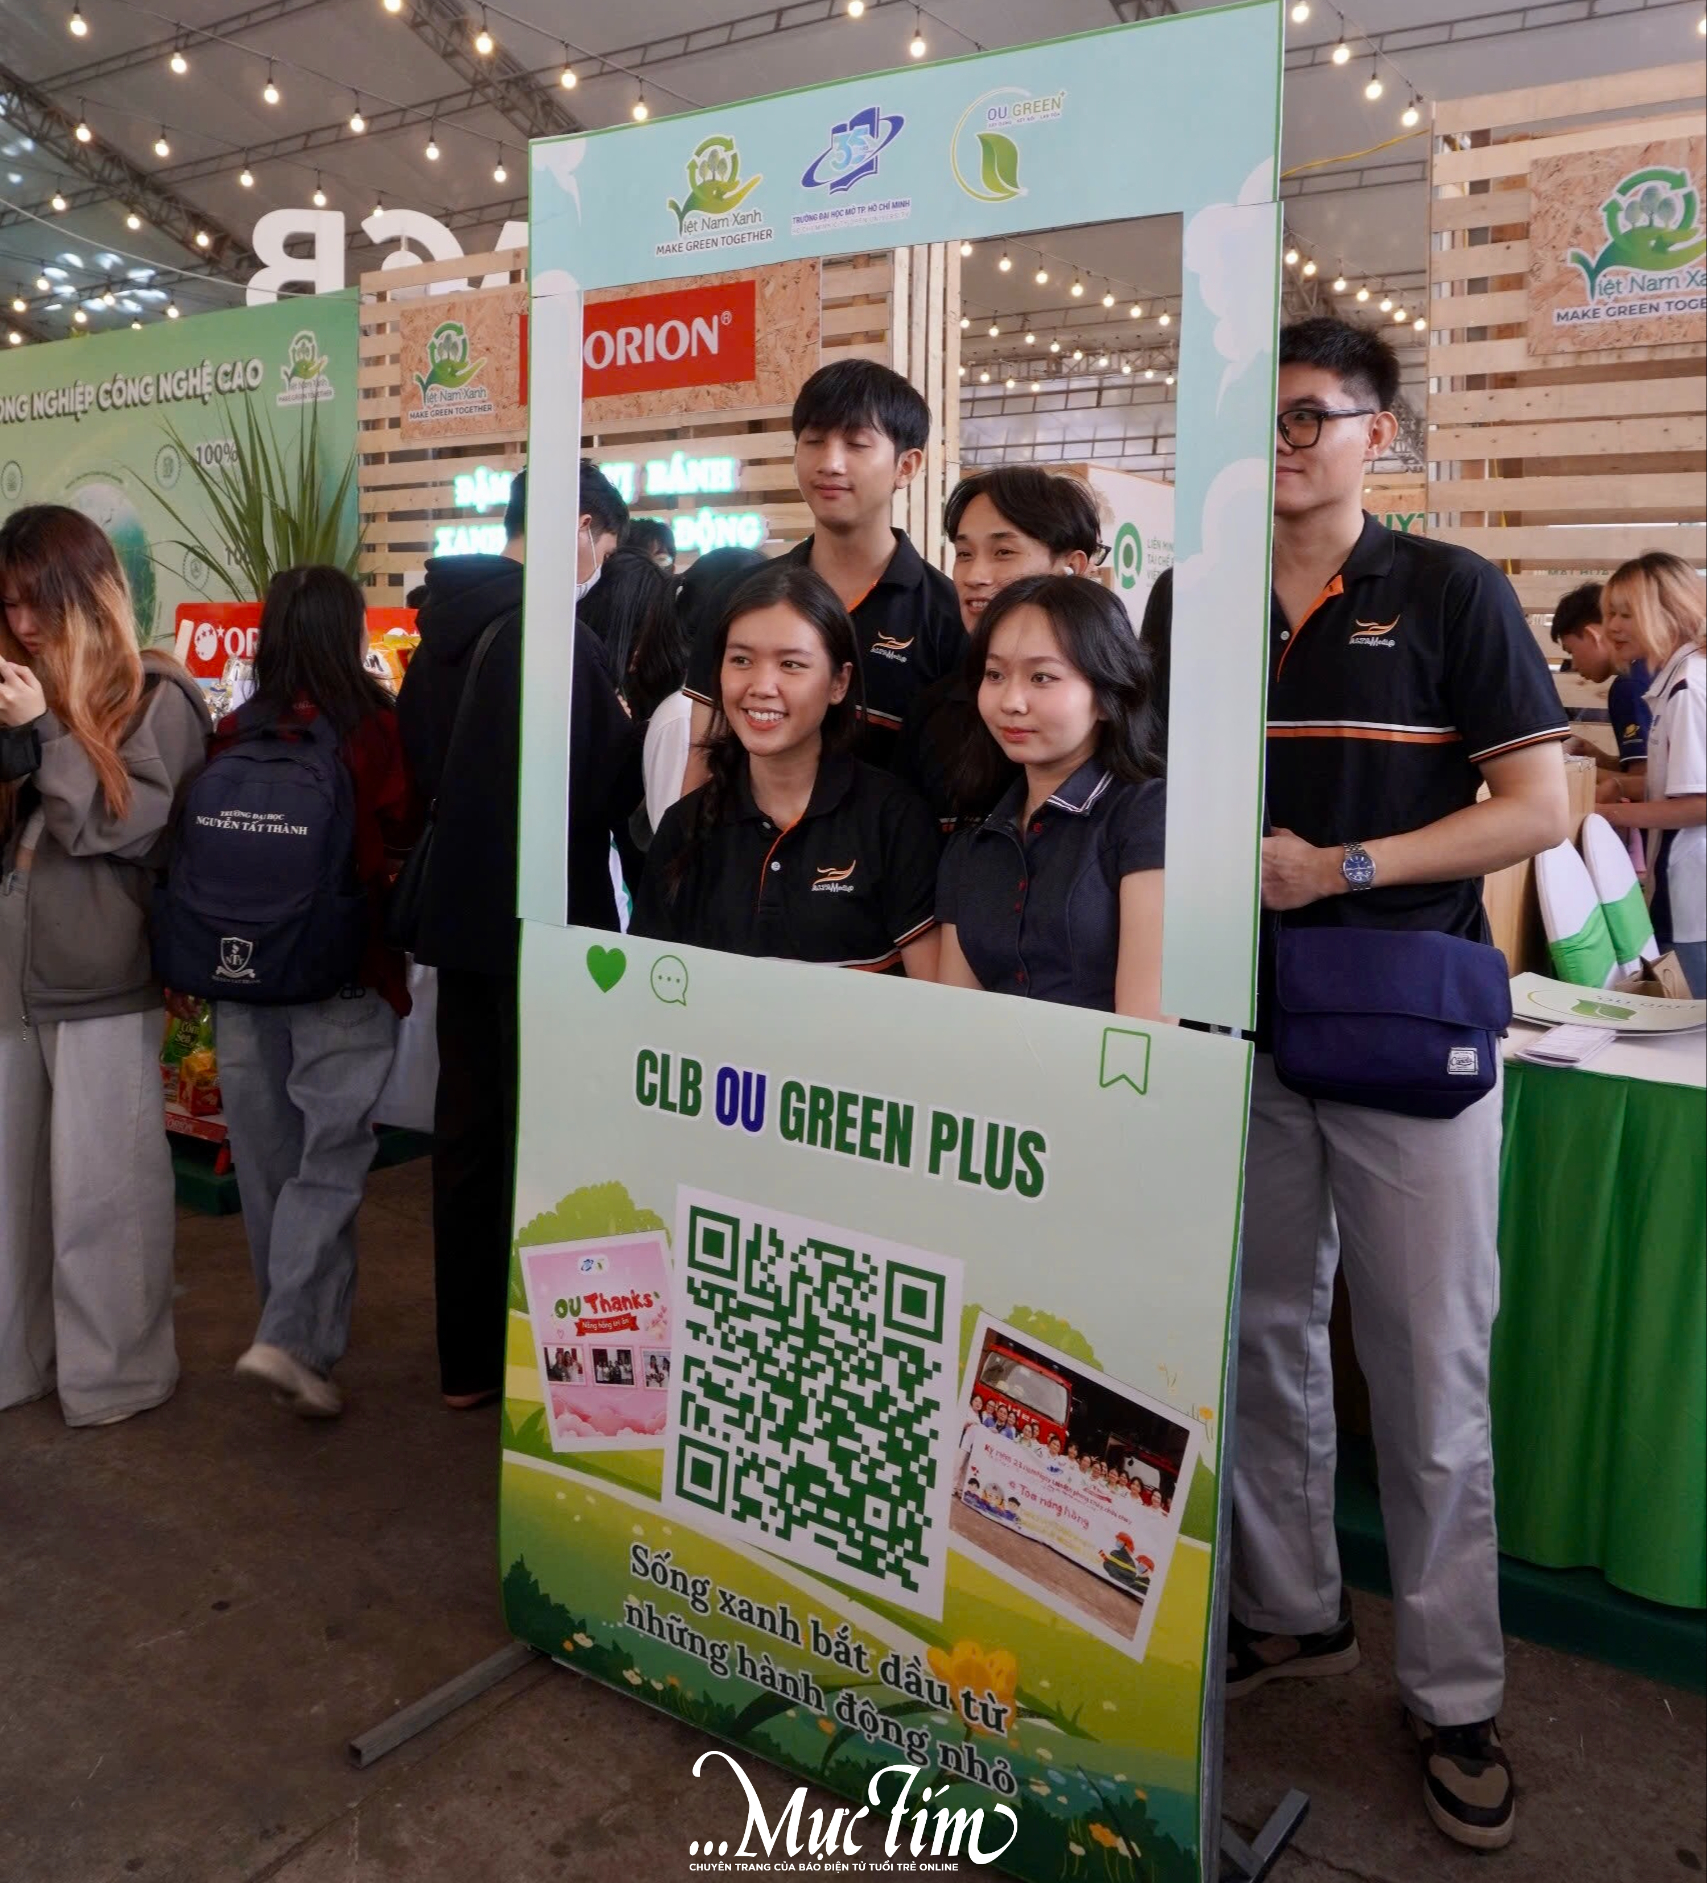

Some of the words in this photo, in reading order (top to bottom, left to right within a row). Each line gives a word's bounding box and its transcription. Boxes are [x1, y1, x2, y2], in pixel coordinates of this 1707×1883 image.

[987, 106, 1007, 121] OU
[831, 210, 844, 220] HỌC
[891, 199, 910, 209] MINH
[701, 215, 729, 232] Nam
[731, 211, 762, 228] Xanh
[656, 242, 684, 256] MAKE
[685, 238, 719, 252] GREEN
[721, 228, 773, 248] TOGETHER
[1629, 274, 1680, 293] Nam
[1556, 307, 1601, 321] MAKE
[1606, 303, 1659, 317] GREEN
[583, 314, 719, 370] ORION
[31, 380, 94, 421] NGHIỆP
[97, 373, 154, 411] CÔNG
[157, 360, 213, 404] NGHỆ
[216, 358, 263, 394] CAO
[440, 389, 460, 401] Nam
[463, 387, 487, 400] Xanh
[410, 411, 429, 420] MAKE
[430, 408, 453, 417] GREEN
[455, 404, 492, 415] TOGETHER
[196, 815, 239, 830] NGUYỄN
[242, 820, 265, 832] TẤT
[266, 823, 308, 835] THÀNH
[636, 1048, 702, 1118] CLB
[715, 1066, 766, 1133] OU
[780, 1080, 914, 1168] GREEN
[928, 1110, 1047, 1198] PLUS
[555, 1296, 581, 1319] OU
[583, 1289, 654, 1315] Thanks
[631, 1545, 710, 1613] Sống
[718, 1588, 801, 1645] xanh
[811, 1618, 870, 1674] bắt
[961, 1690, 1008, 1734] từ
[626, 1602, 729, 1675] những
[737, 1646, 824, 1721] hành
[834, 1691, 928, 1766] động
[937, 1743, 1015, 1795] nhỏ
